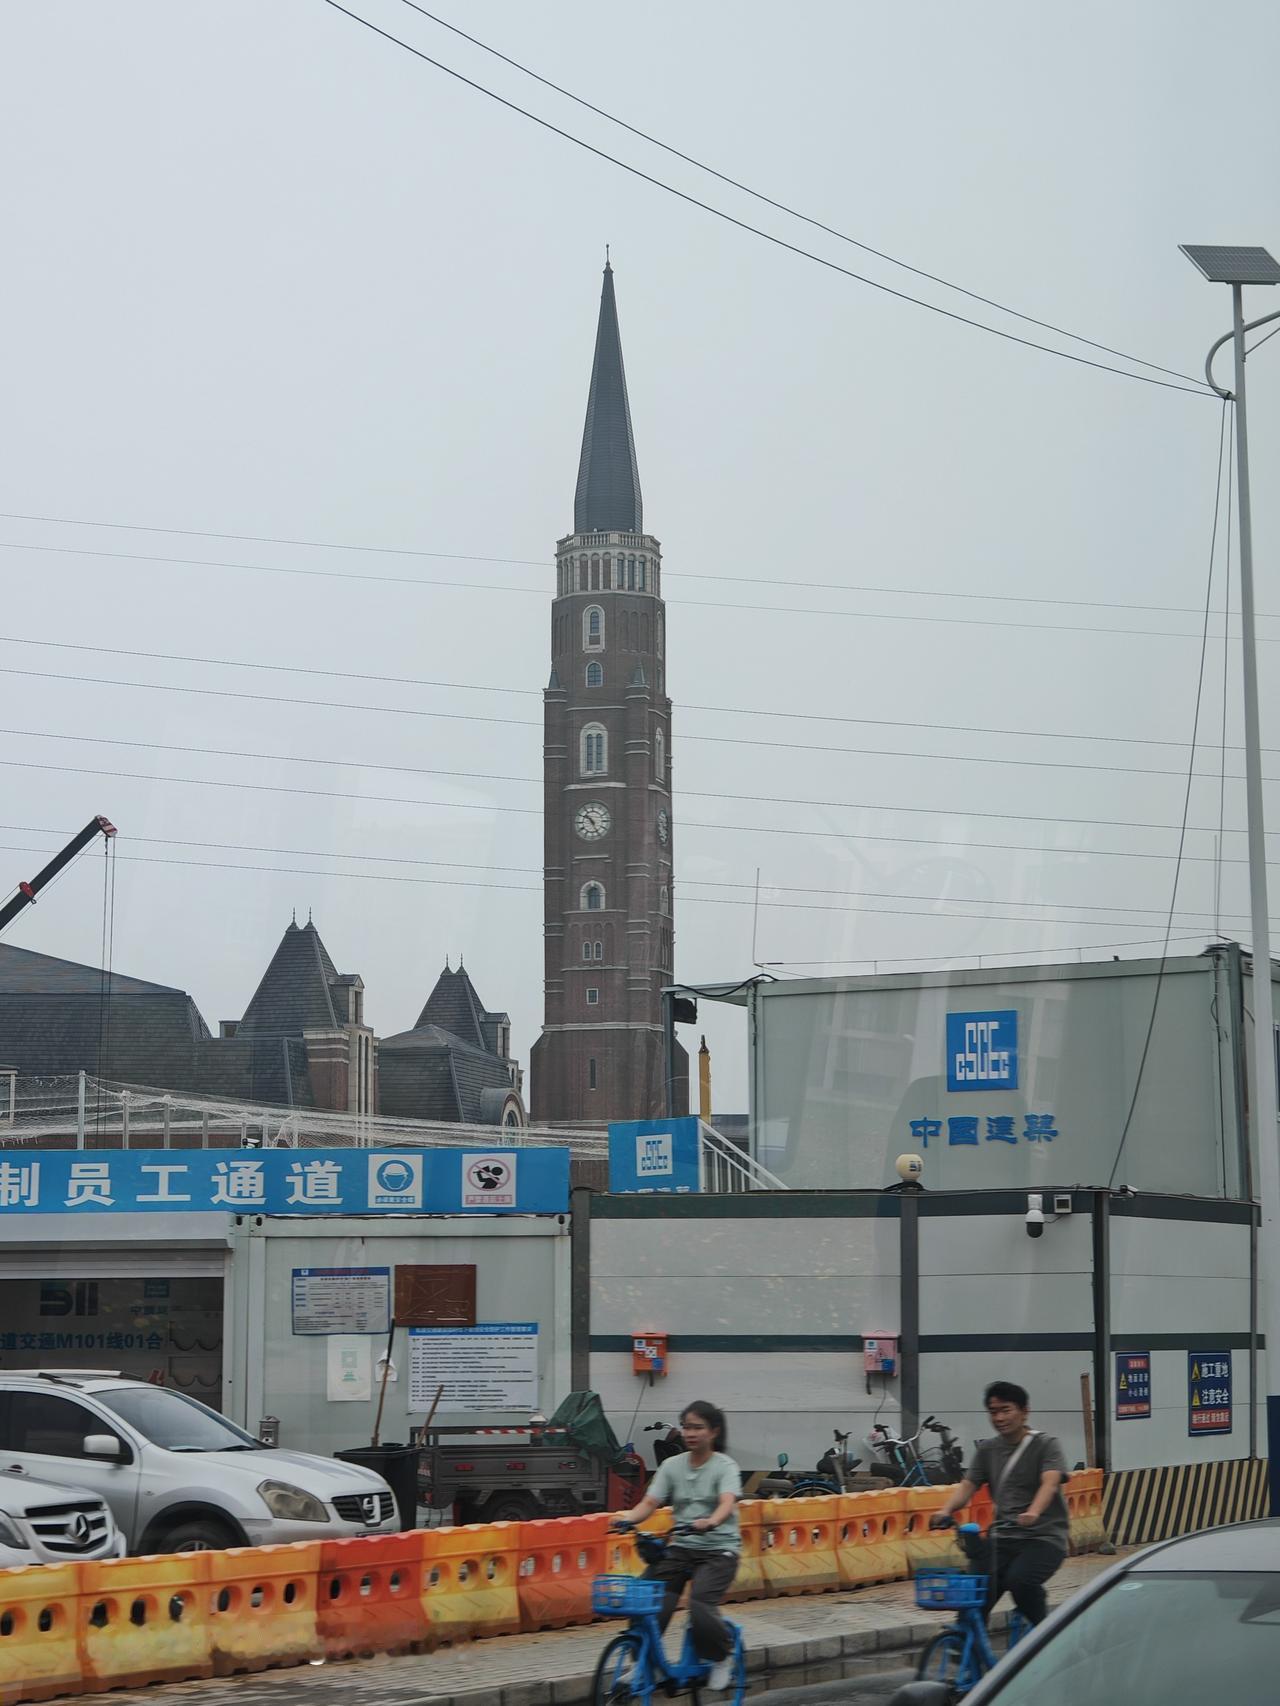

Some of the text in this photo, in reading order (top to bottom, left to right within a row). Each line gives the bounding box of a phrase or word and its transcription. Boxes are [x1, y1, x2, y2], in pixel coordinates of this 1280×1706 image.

[1201, 1362, 1228, 1378] 施工重地
[1201, 1388, 1229, 1405] 注意安全
